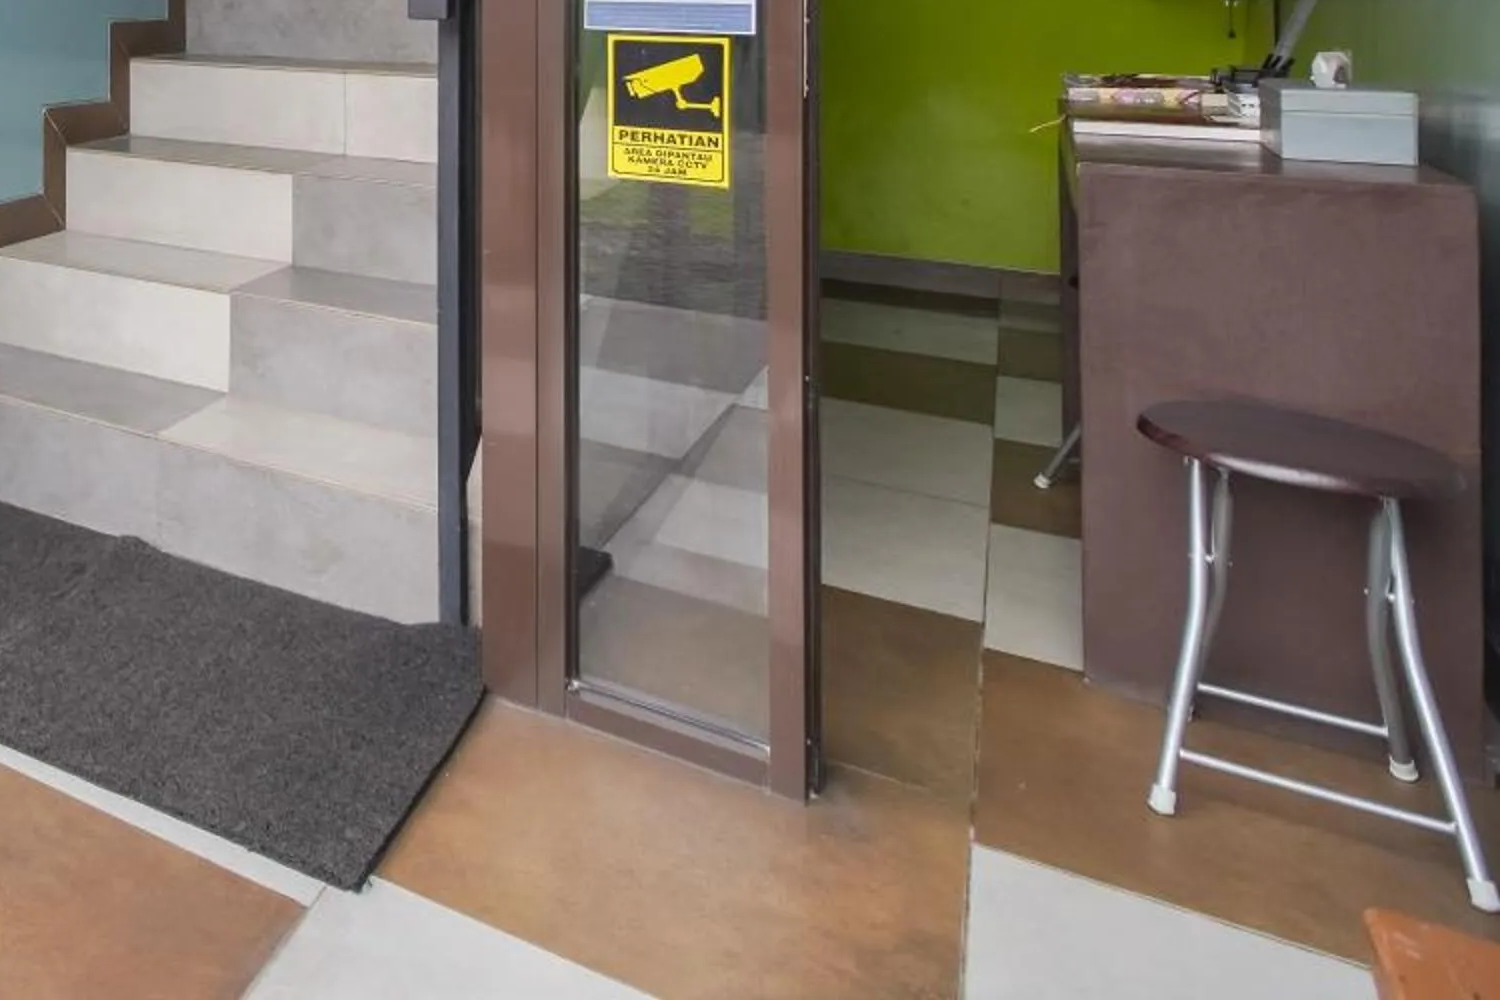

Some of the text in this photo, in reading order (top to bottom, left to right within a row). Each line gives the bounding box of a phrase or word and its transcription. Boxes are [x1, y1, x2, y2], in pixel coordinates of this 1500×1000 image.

[619, 129, 719, 149] PERHATIAN
[624, 148, 713, 162] AREA DIPANTAU
[627, 156, 707, 169] KAMERA CCTV
[663, 167, 687, 175] JAM
